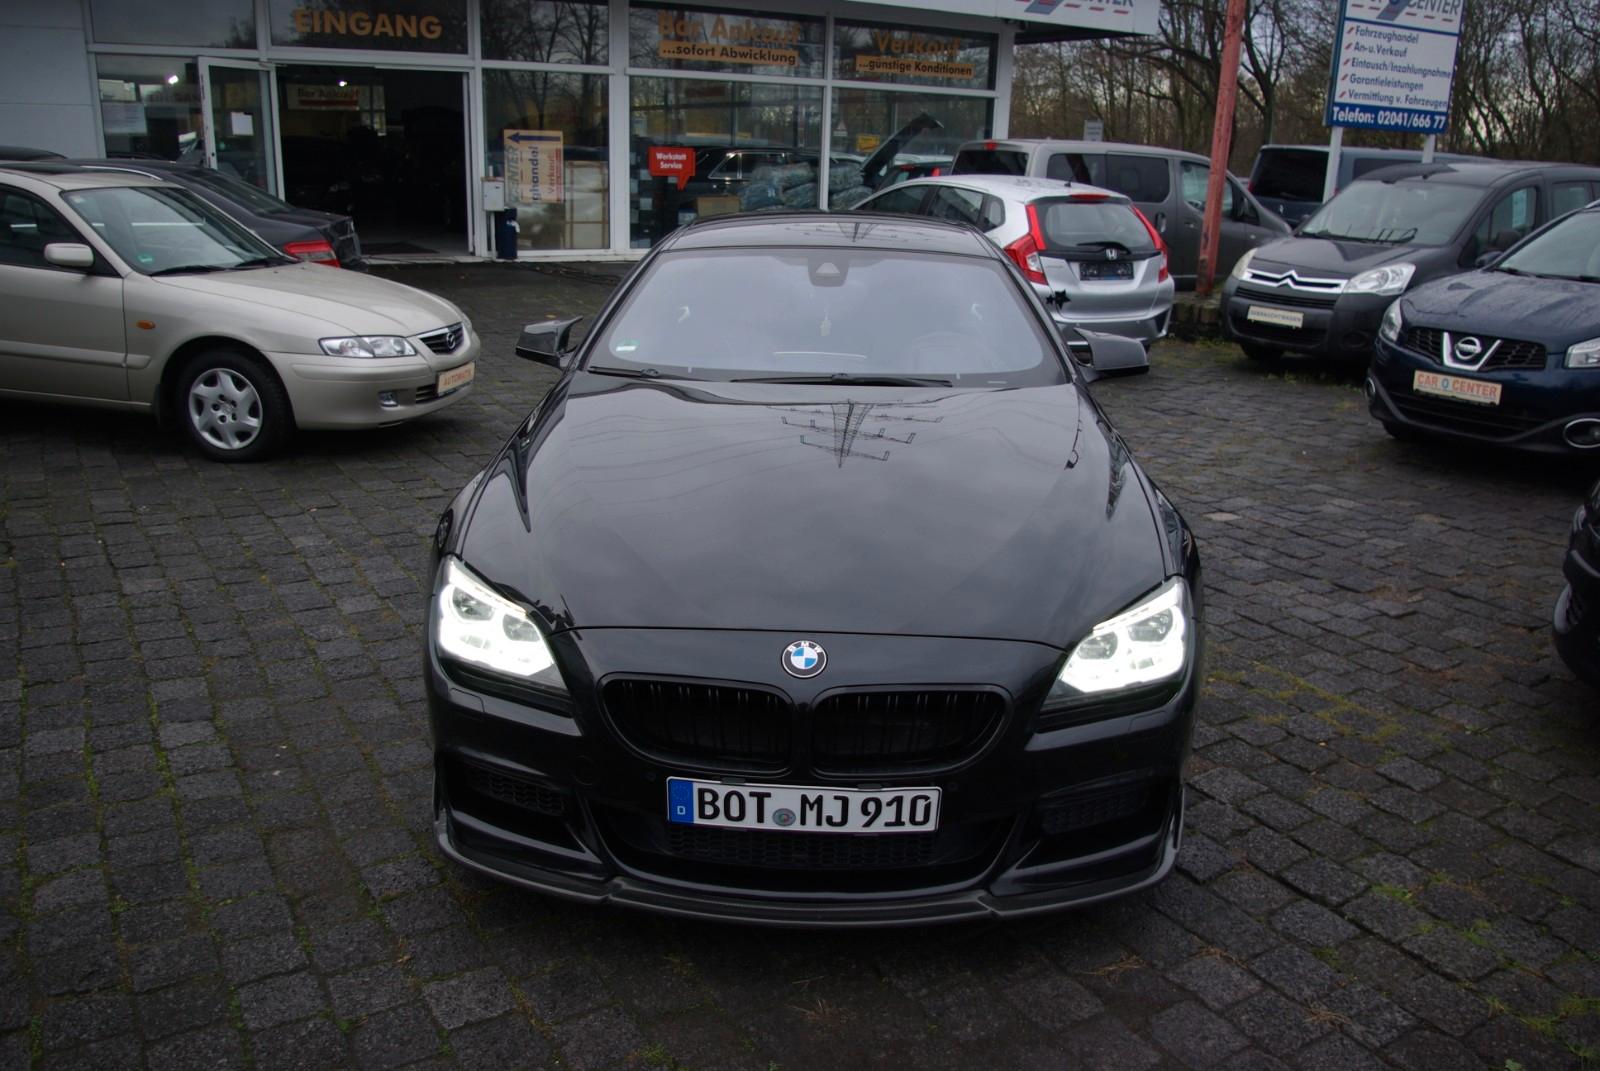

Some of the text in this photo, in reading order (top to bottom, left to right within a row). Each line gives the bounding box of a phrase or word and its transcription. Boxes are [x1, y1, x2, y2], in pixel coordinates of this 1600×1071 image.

[295, 9, 442, 39] EINGANG
[658, 9, 800, 43] Bar Ankauf
[1355, 25, 1419, 43] Fahrzeughandel
[873, 31, 961, 57] Verkauf
[719, 47, 796, 65] Abwicklung
[914, 62, 972, 75] Konditionen
[1350, 73, 1424, 92] Garantieleistungen
[1348, 89, 1394, 105] Vermittlung
[1404, 94, 1447, 109] Fahrzeugen
[1333, 106, 1446, 129] Telefon: 02041/666 77
[656, 151, 687, 160] Werkstatt
[660, 161, 683, 169] Service
[1417, 373, 1439, 387] CAR
[1452, 379, 1497, 397] CENTER
[677, 787, 932, 828] D BOT MJ 910
